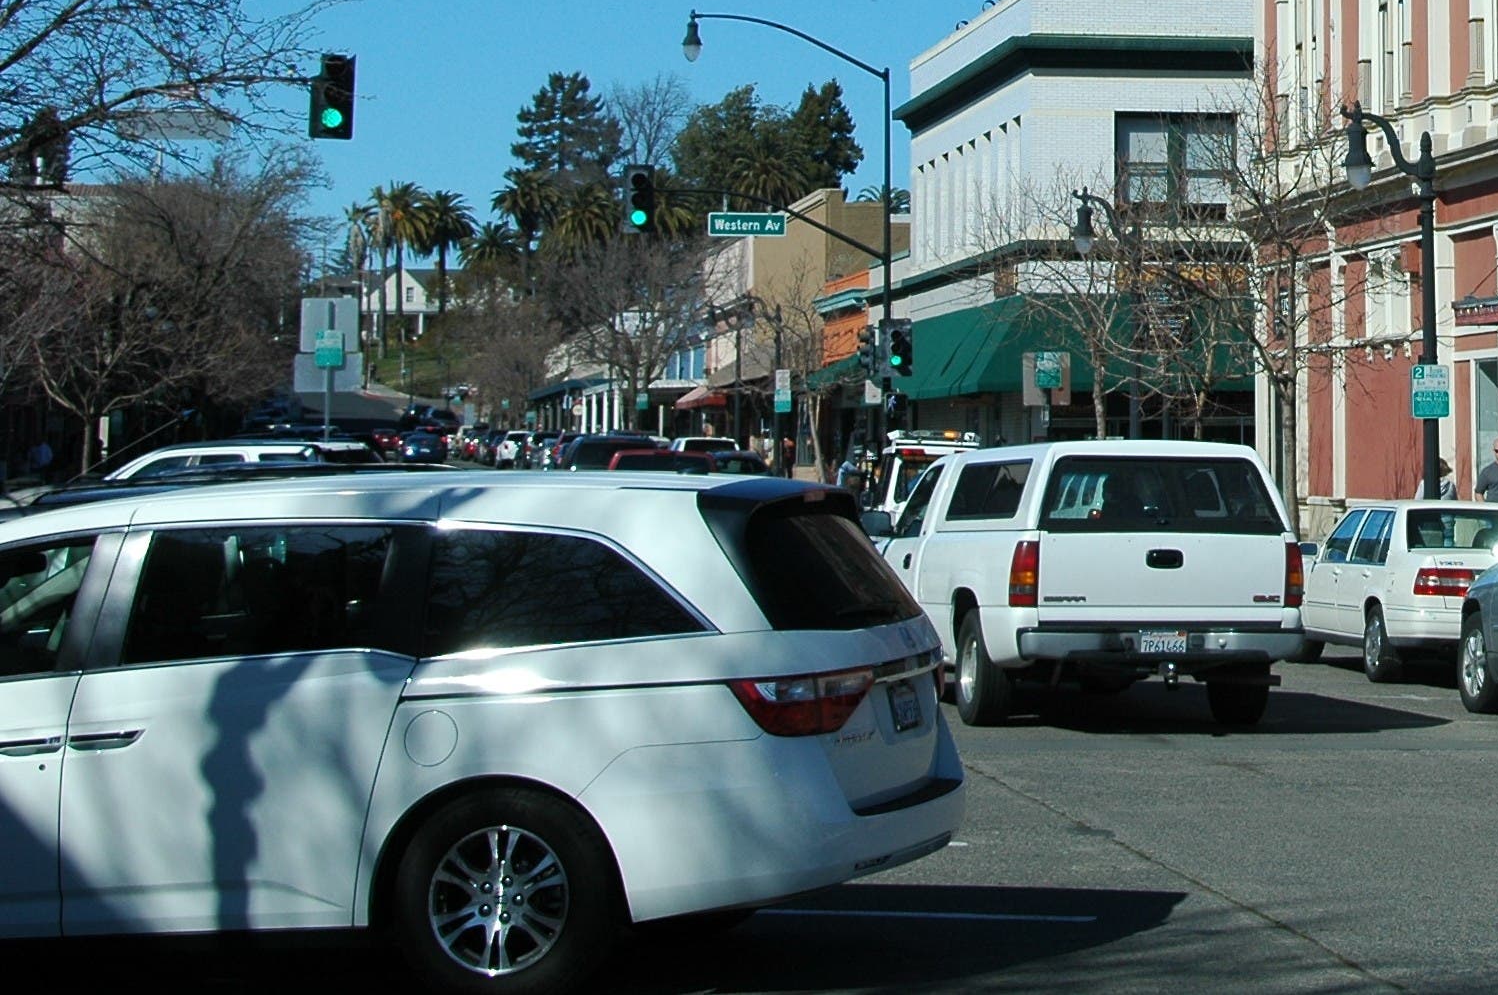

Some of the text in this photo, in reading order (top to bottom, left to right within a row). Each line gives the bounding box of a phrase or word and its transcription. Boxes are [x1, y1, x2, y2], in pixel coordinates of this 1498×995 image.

[714, 218, 780, 231] Western Av
[1415, 367, 1423, 378] 2
